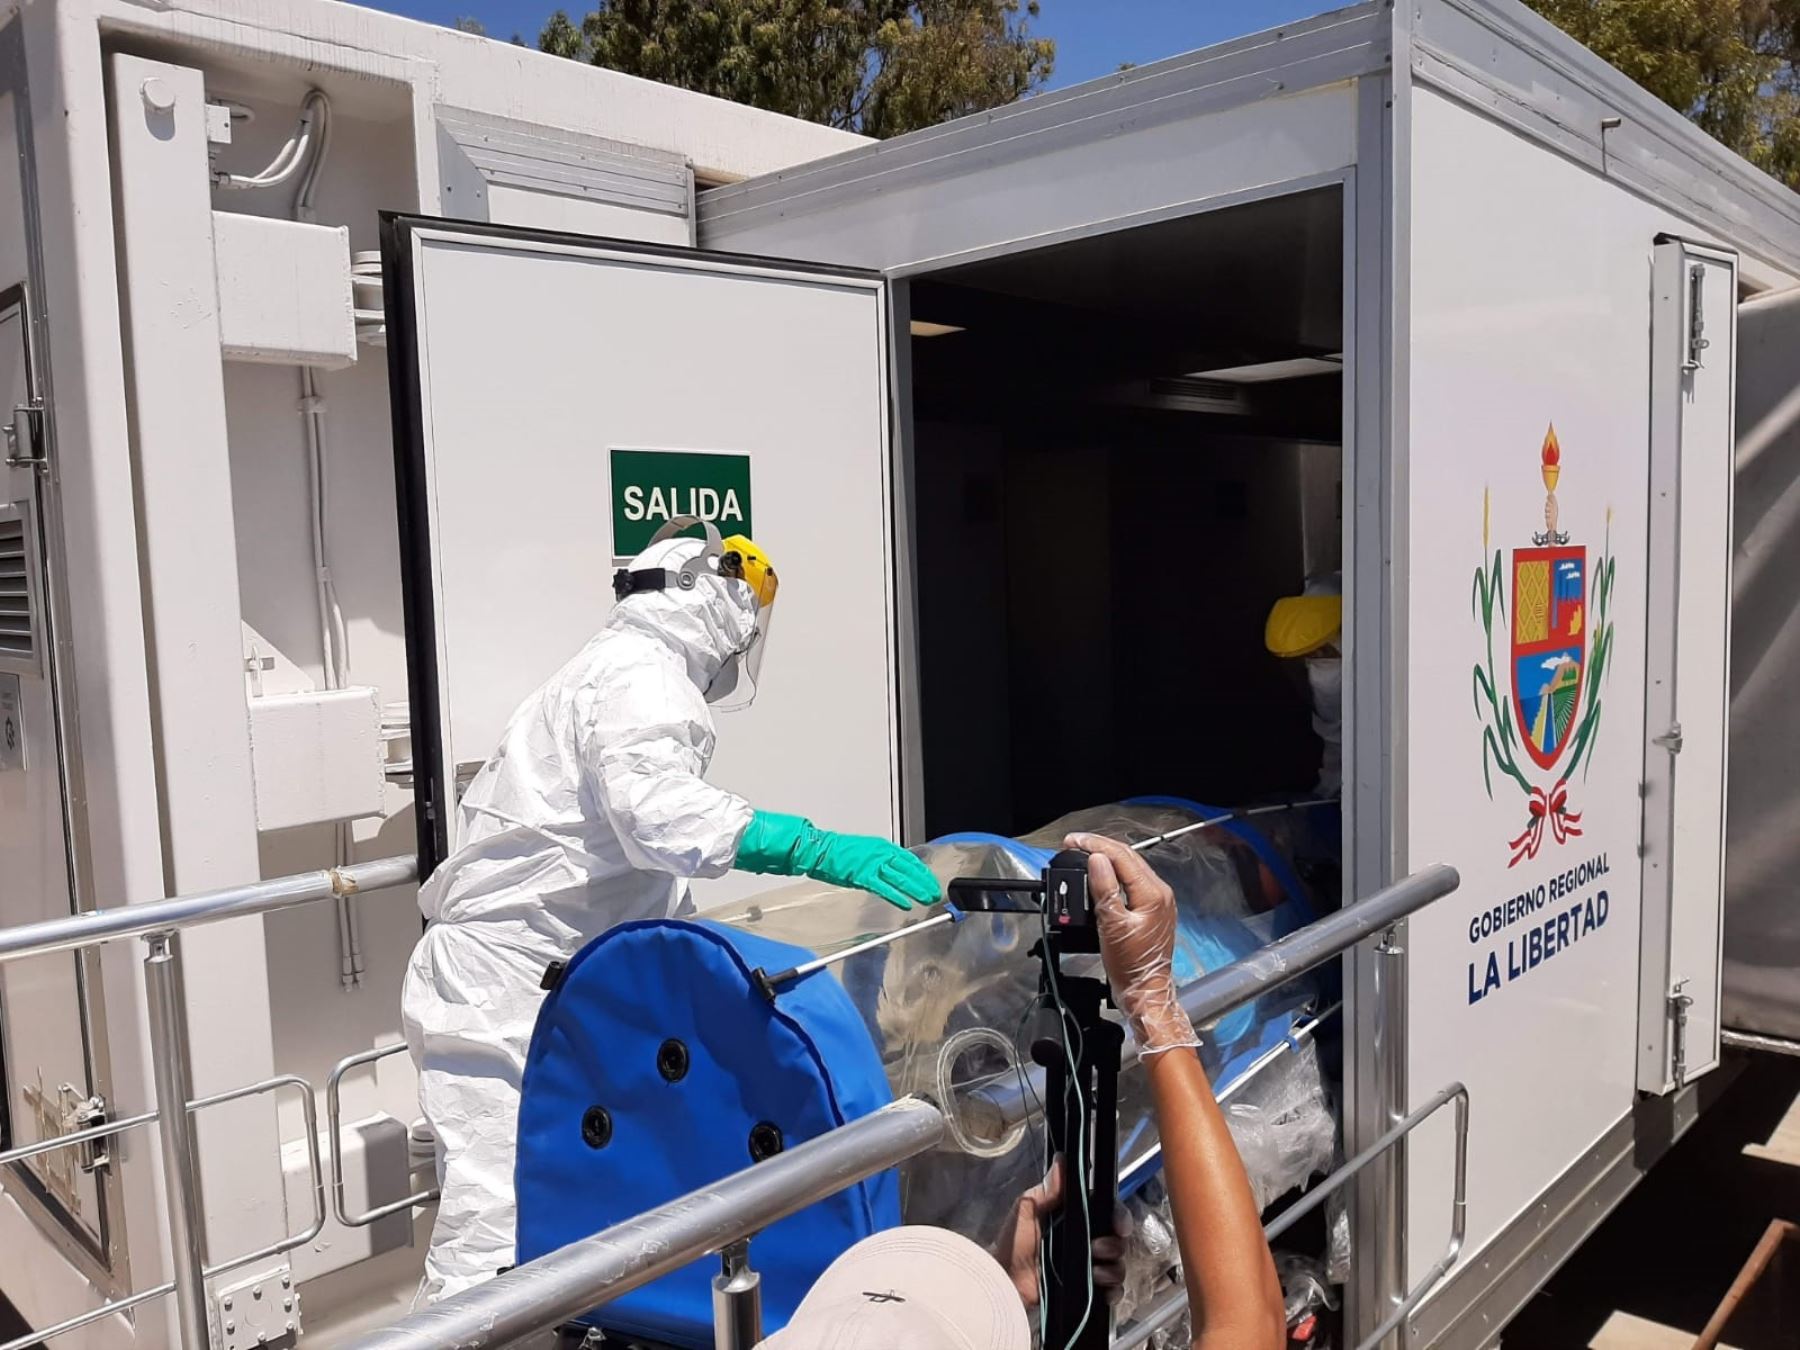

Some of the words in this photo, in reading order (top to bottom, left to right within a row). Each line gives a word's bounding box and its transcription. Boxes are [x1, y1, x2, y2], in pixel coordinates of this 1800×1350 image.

[624, 486, 743, 521] SALIDA
[1469, 884, 1545, 943] GOBIERNO
[1549, 852, 1610, 902] REGIONAL
[1469, 951, 1500, 1005] LA
[1508, 890, 1609, 981] LIBERTAD
